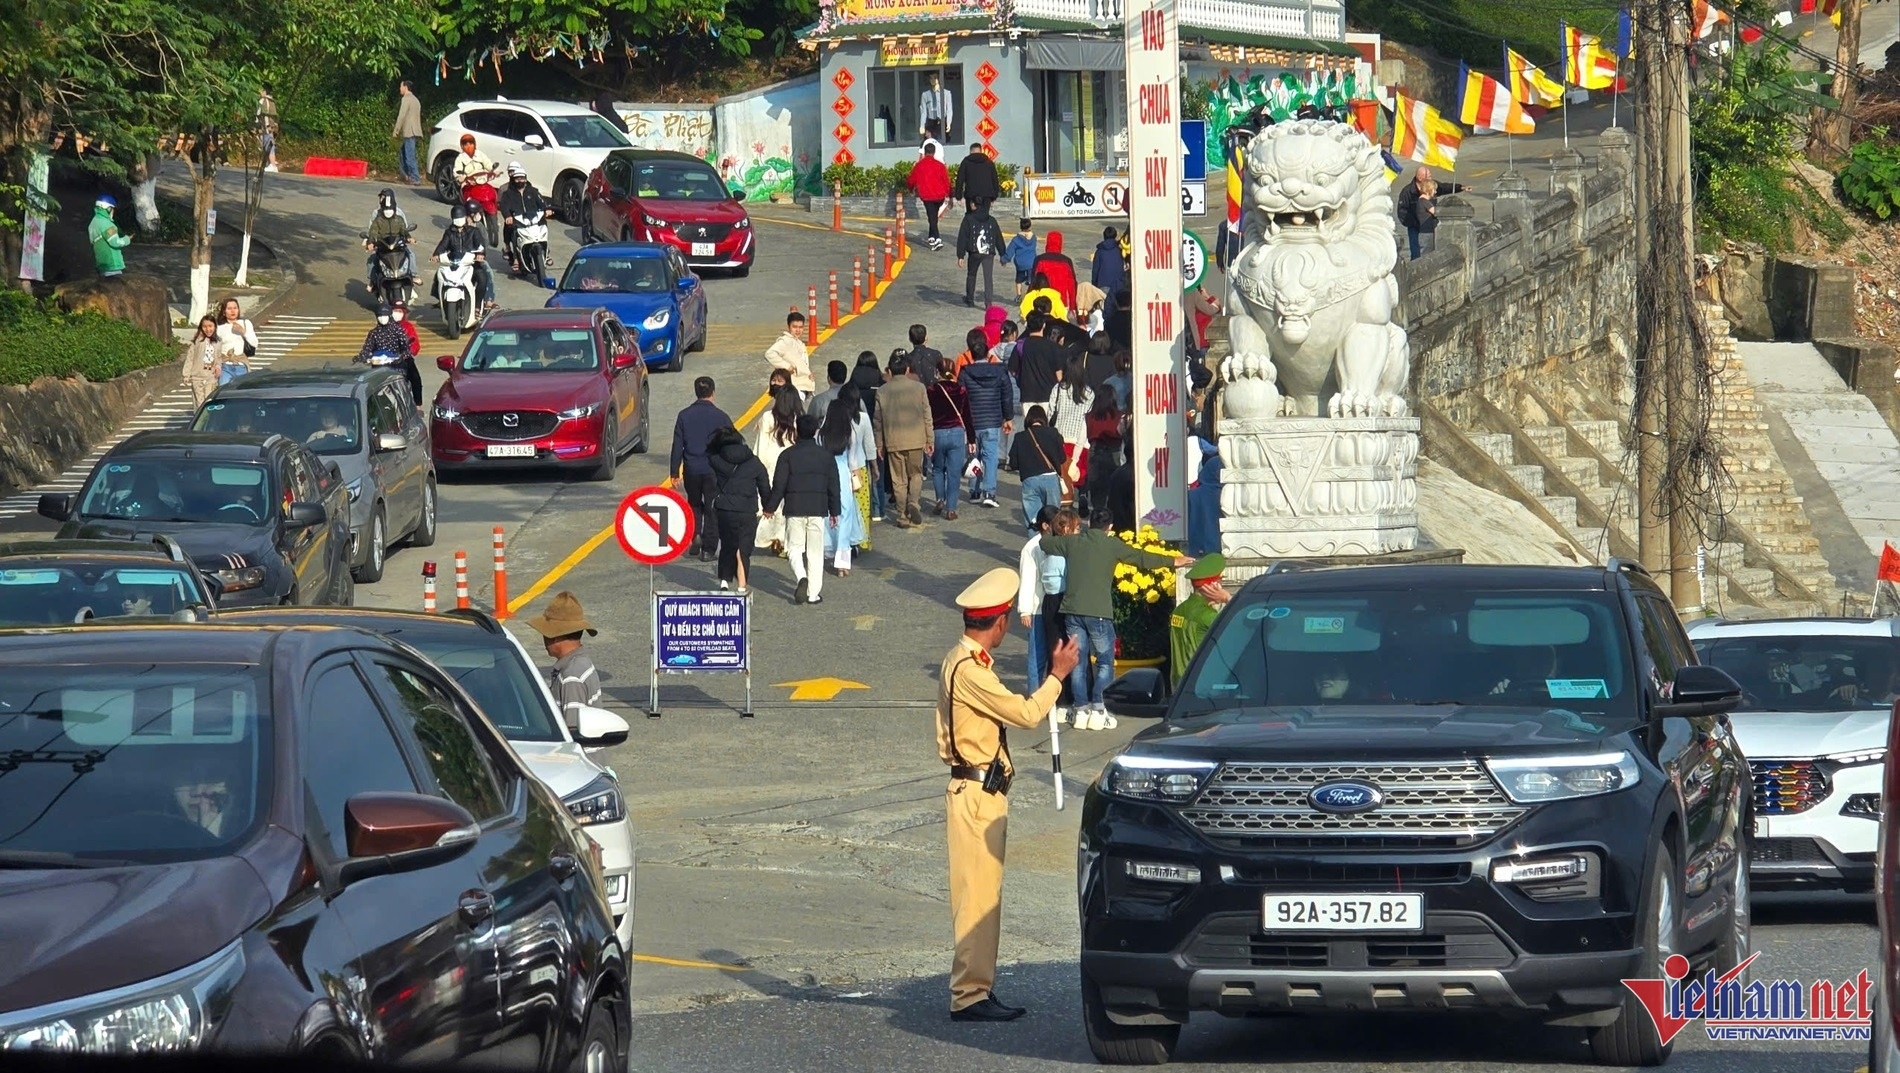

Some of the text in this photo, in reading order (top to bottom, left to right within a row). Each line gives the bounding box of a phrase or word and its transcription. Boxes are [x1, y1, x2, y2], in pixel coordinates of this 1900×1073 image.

[1141, 2, 1165, 51] VÀO
[1139, 75, 1171, 125] CHÙA
[1145, 149, 1168, 198] HÃY
[1145, 230, 1173, 270] SINH
[1147, 292, 1173, 342] TÂM
[1146, 373, 1178, 415] HOAN
[662, 621, 672, 636] TỪ
[672, 624, 677, 636] 4
[677, 620, 691, 636] ĐẾN
[692, 624, 700, 636] 52
[717, 621, 730, 637] QUÁ
[731, 620, 741, 636] TẢI
[665, 601, 739, 617] QUÝ KHÁCH THÔNG CẢM
[1327, 788, 1363, 804] Ford
[1277, 901, 1408, 924] 92A-357.82
